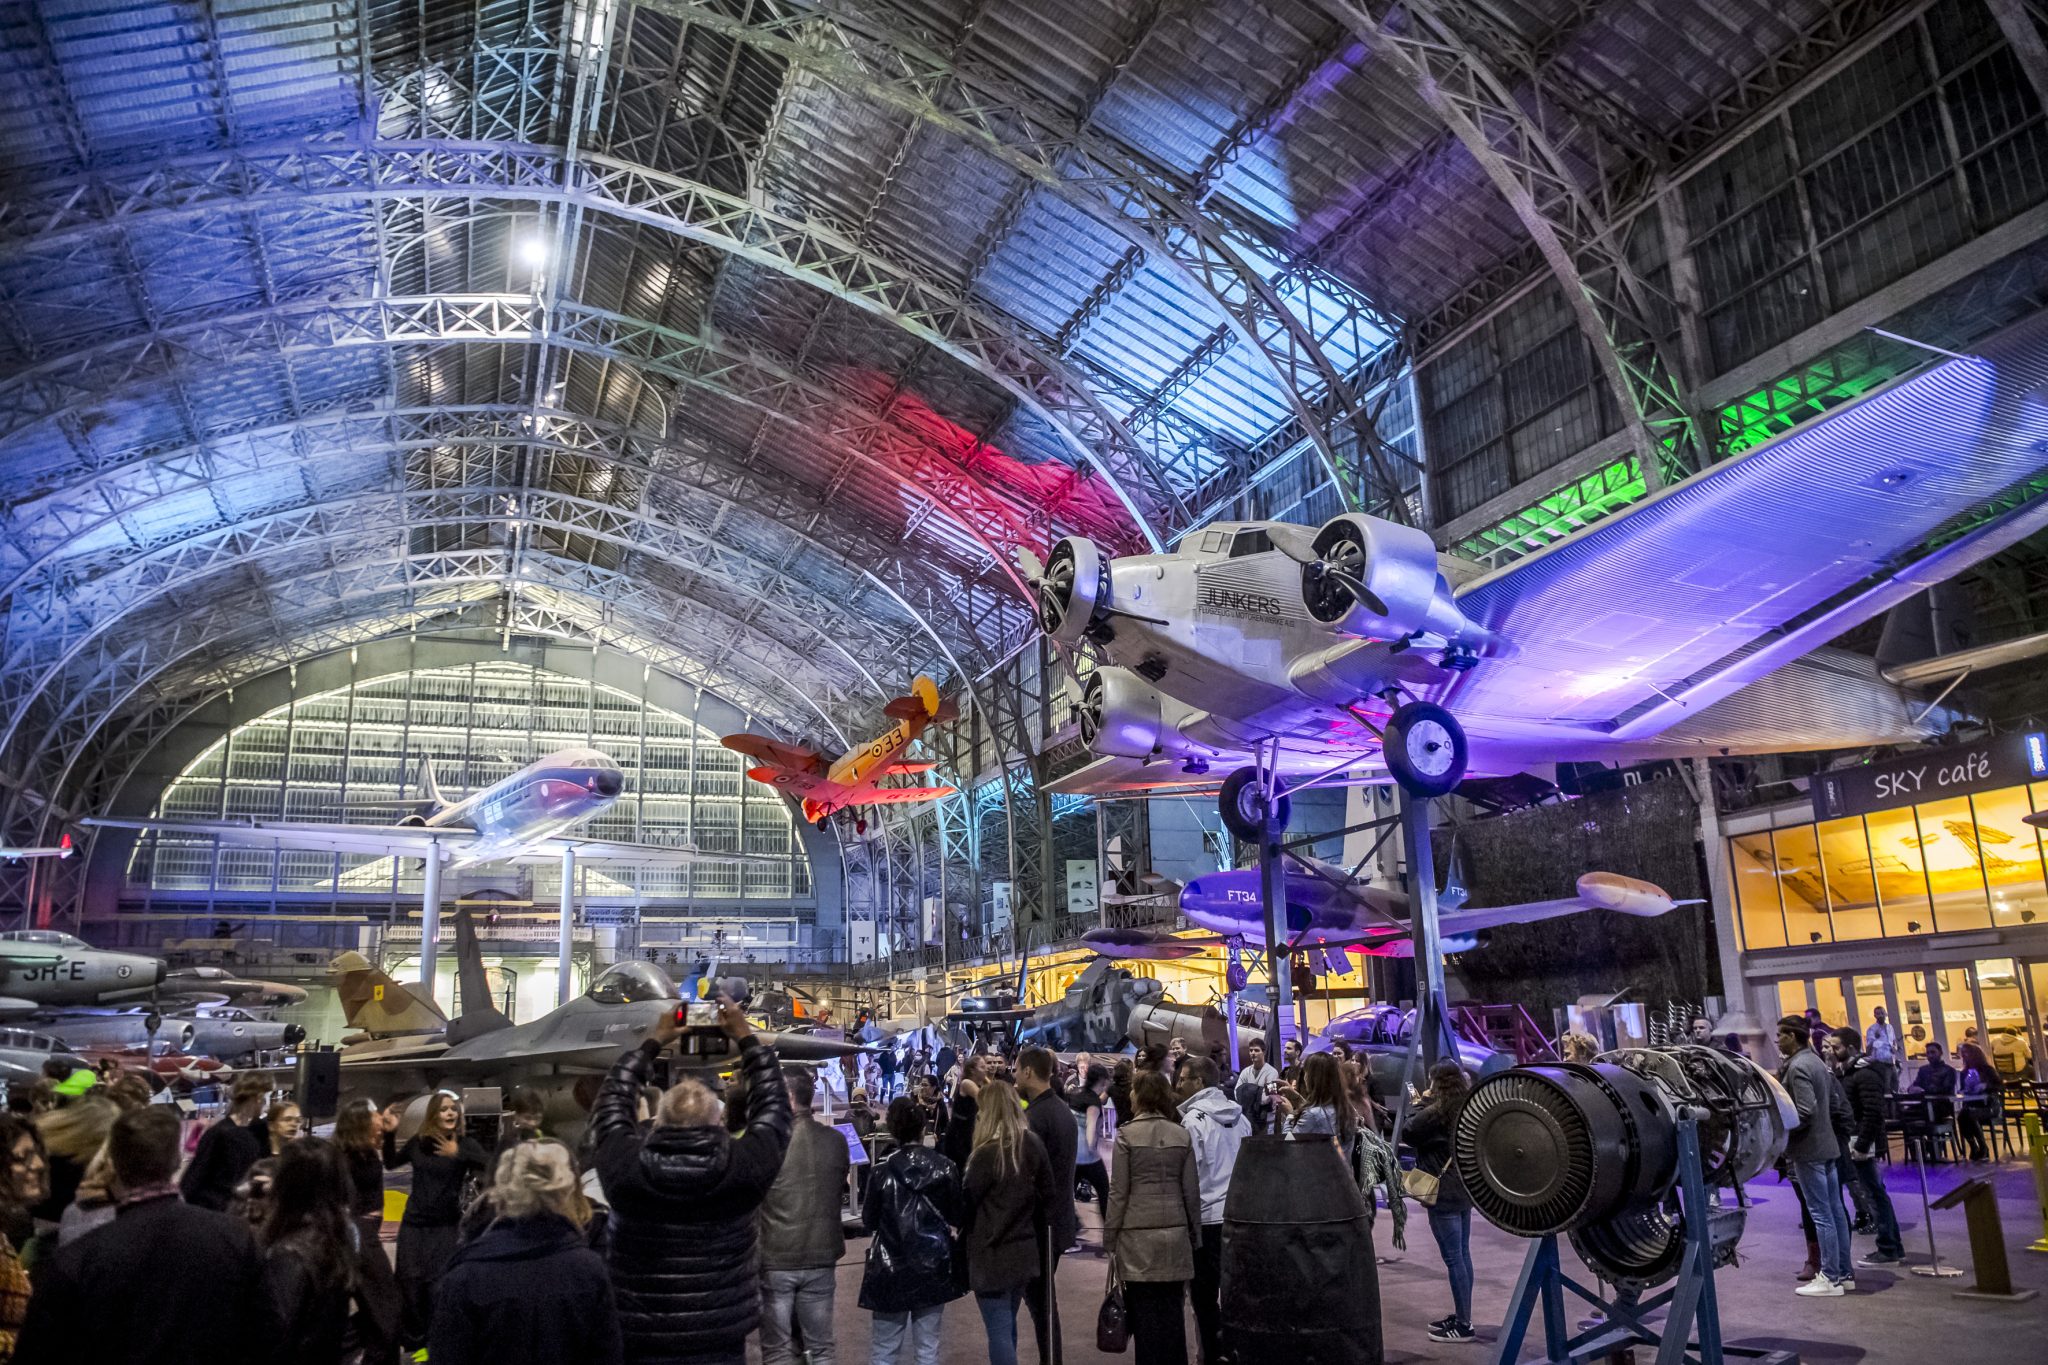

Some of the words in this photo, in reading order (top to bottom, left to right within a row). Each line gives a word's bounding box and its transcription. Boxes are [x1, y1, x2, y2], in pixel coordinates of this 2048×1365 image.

[1198, 606, 1231, 618] FLUGZEUG
[1204, 588, 1280, 615] JUNKERS
[882, 728, 904, 754] 33
[1874, 766, 1928, 799] SKY
[1938, 751, 1992, 786] café
[1227, 889, 1257, 903] FT34
